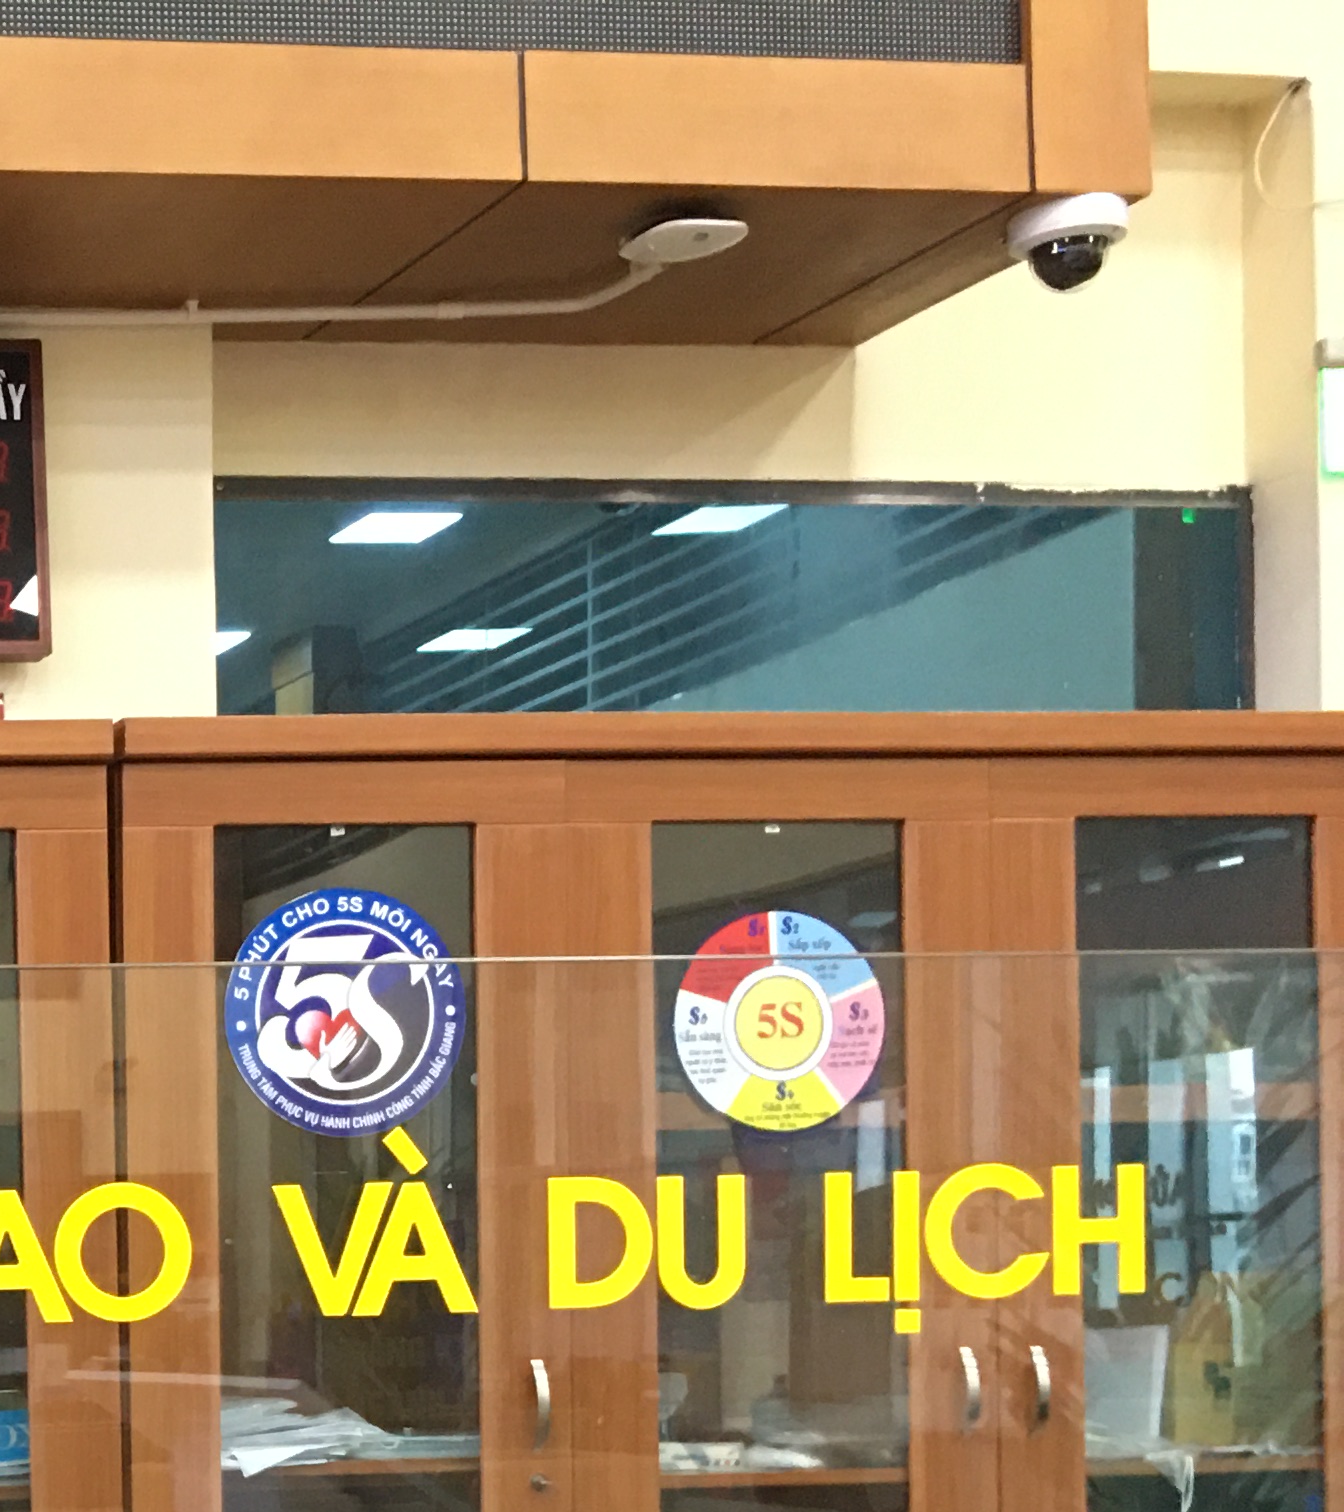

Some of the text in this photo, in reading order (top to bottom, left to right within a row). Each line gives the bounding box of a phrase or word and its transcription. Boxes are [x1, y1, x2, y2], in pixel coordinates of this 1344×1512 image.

[281, 898, 330, 928] CHO
[337, 896, 363, 912] 5S
[238, 923, 278, 981] PHÚT
[234, 986, 250, 1000] 5
[756, 1001, 805, 1039] 5S
[238, 1043, 262, 1081] TRUNG
[257, 1077, 279, 1101] TÂM
[274, 1095, 303, 1117] PHỤC
[304, 1110, 320, 1127] VỤ
[385, 1095, 414, 1119] CÔNG
[439, 1021, 457, 1056] GIANG
[271, 1127, 479, 1318] VÀ
[548, 1173, 747, 1312] DU
[823, 1161, 1148, 1336] LỊCH
